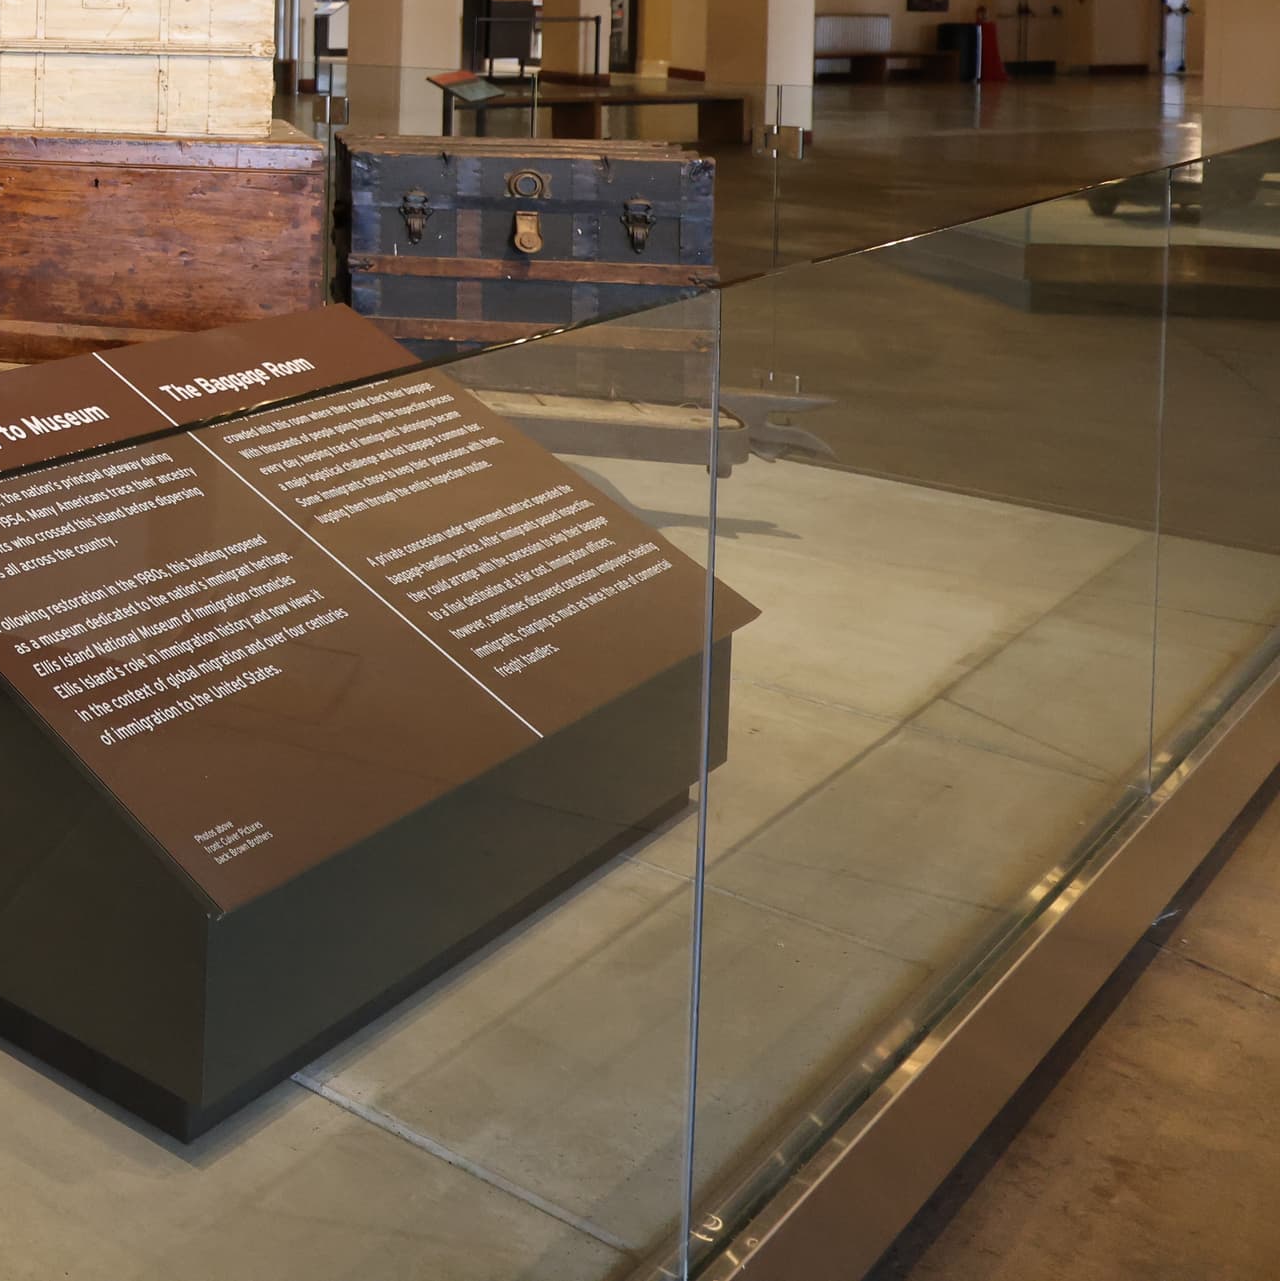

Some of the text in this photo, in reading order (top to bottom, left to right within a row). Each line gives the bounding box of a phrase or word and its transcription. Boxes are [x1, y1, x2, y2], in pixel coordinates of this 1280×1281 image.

[158, 358, 315, 402] The Baggage Room
[20, 406, 110, 435] Museum
[0, 492, 22, 504] the
[20, 481, 63, 499] nation's
[60, 469, 104, 490] principal
[102, 460, 144, 479] gateway
[140, 452, 174, 466] during
[25, 506, 58, 520] Many
[55, 491, 110, 512] Americans
[105, 484, 135, 497] trace
[131, 477, 157, 490] their
[155, 467, 197, 484] ancestry
[10, 536, 36, 548] who
[34, 522, 77, 542] crossed
[72, 517, 97, 530] this
[92, 507, 126, 524] island
[121, 500, 157, 515] before
[155, 487, 205, 506] dispersing
[4, 562, 21, 576] all
[19, 554, 57, 571] across
[52, 548, 76, 560] the
[74, 536, 118, 554] country.
[46, 589, 109, 615] restoration
[102, 584, 120, 595] in
[115, 579, 138, 592] the
[133, 568, 173, 585] 1980s,
[166, 560, 190, 574] this
[184, 549, 228, 568] building
[223, 534, 268, 555] reopened
[14, 552, 294, 655] as a museum dedicated to the nation's immigrant heritage.
[32, 575, 296, 677] Ellis Island National Museum of Immigration chronicles
[53, 589, 325, 699] Ellis Island's role in immigration history and now views it
